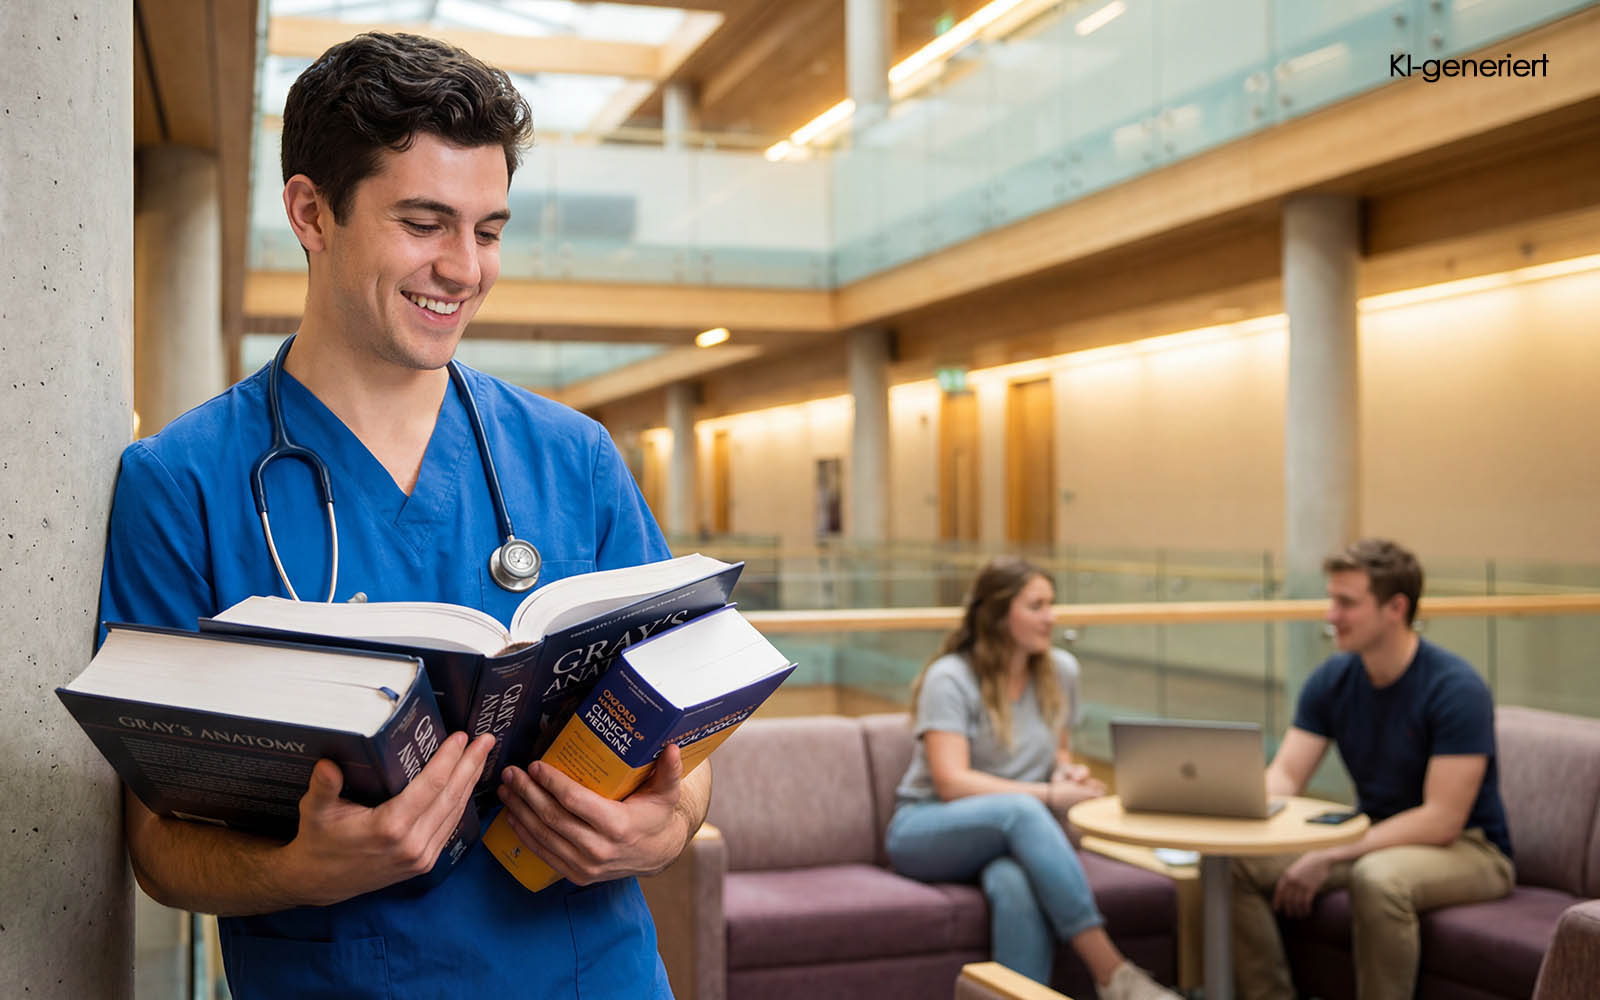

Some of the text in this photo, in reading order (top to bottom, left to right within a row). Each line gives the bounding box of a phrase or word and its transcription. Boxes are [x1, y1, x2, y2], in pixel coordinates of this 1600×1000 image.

[553, 609, 688, 675] GRAY'S
[542, 655, 616, 697] ANAT
[474, 694, 501, 736] ANATO
[493, 683, 523, 733] GRAY'S
[592, 703, 633, 748] CLINICAL
[118, 715, 306, 753] GRAY'S ANATOMY
[414, 715, 439, 763] GRAY
[585, 710, 629, 756] MEDICINE
